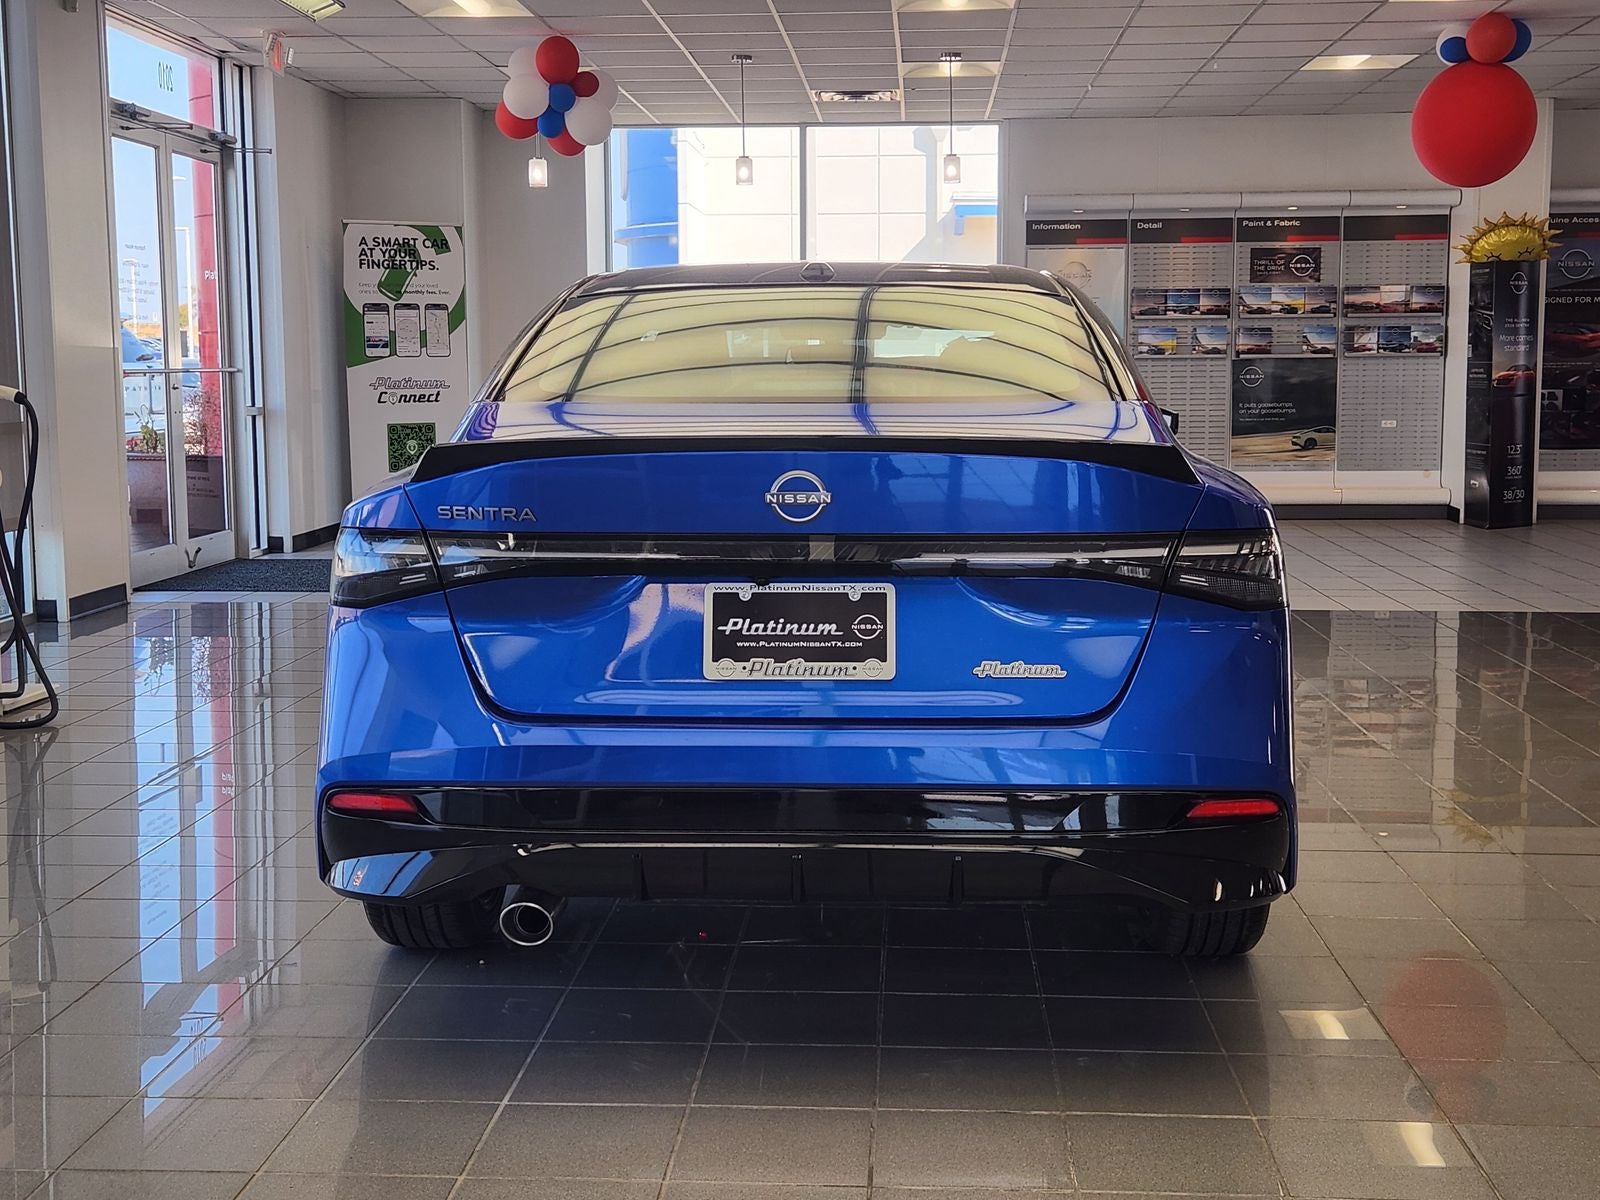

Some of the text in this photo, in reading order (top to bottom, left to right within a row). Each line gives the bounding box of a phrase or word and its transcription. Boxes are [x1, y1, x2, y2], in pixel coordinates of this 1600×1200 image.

[359, 237, 449, 249] A SMART CAR
[359, 248, 416, 259] AT YOUR
[359, 259, 439, 270] FINGERTIPS.
[369, 377, 450, 389] Platinum
[766, 494, 831, 504] NISSAN
[1503, 489, 1525, 499] 38/30
[437, 505, 537, 521] SENTRA
[714, 584, 887, 592] www.PlatinumNissanTX.com
[717, 618, 844, 635] Platinum
[748, 660, 856, 677] Platinum
[972, 660, 1067, 678] Platinum
